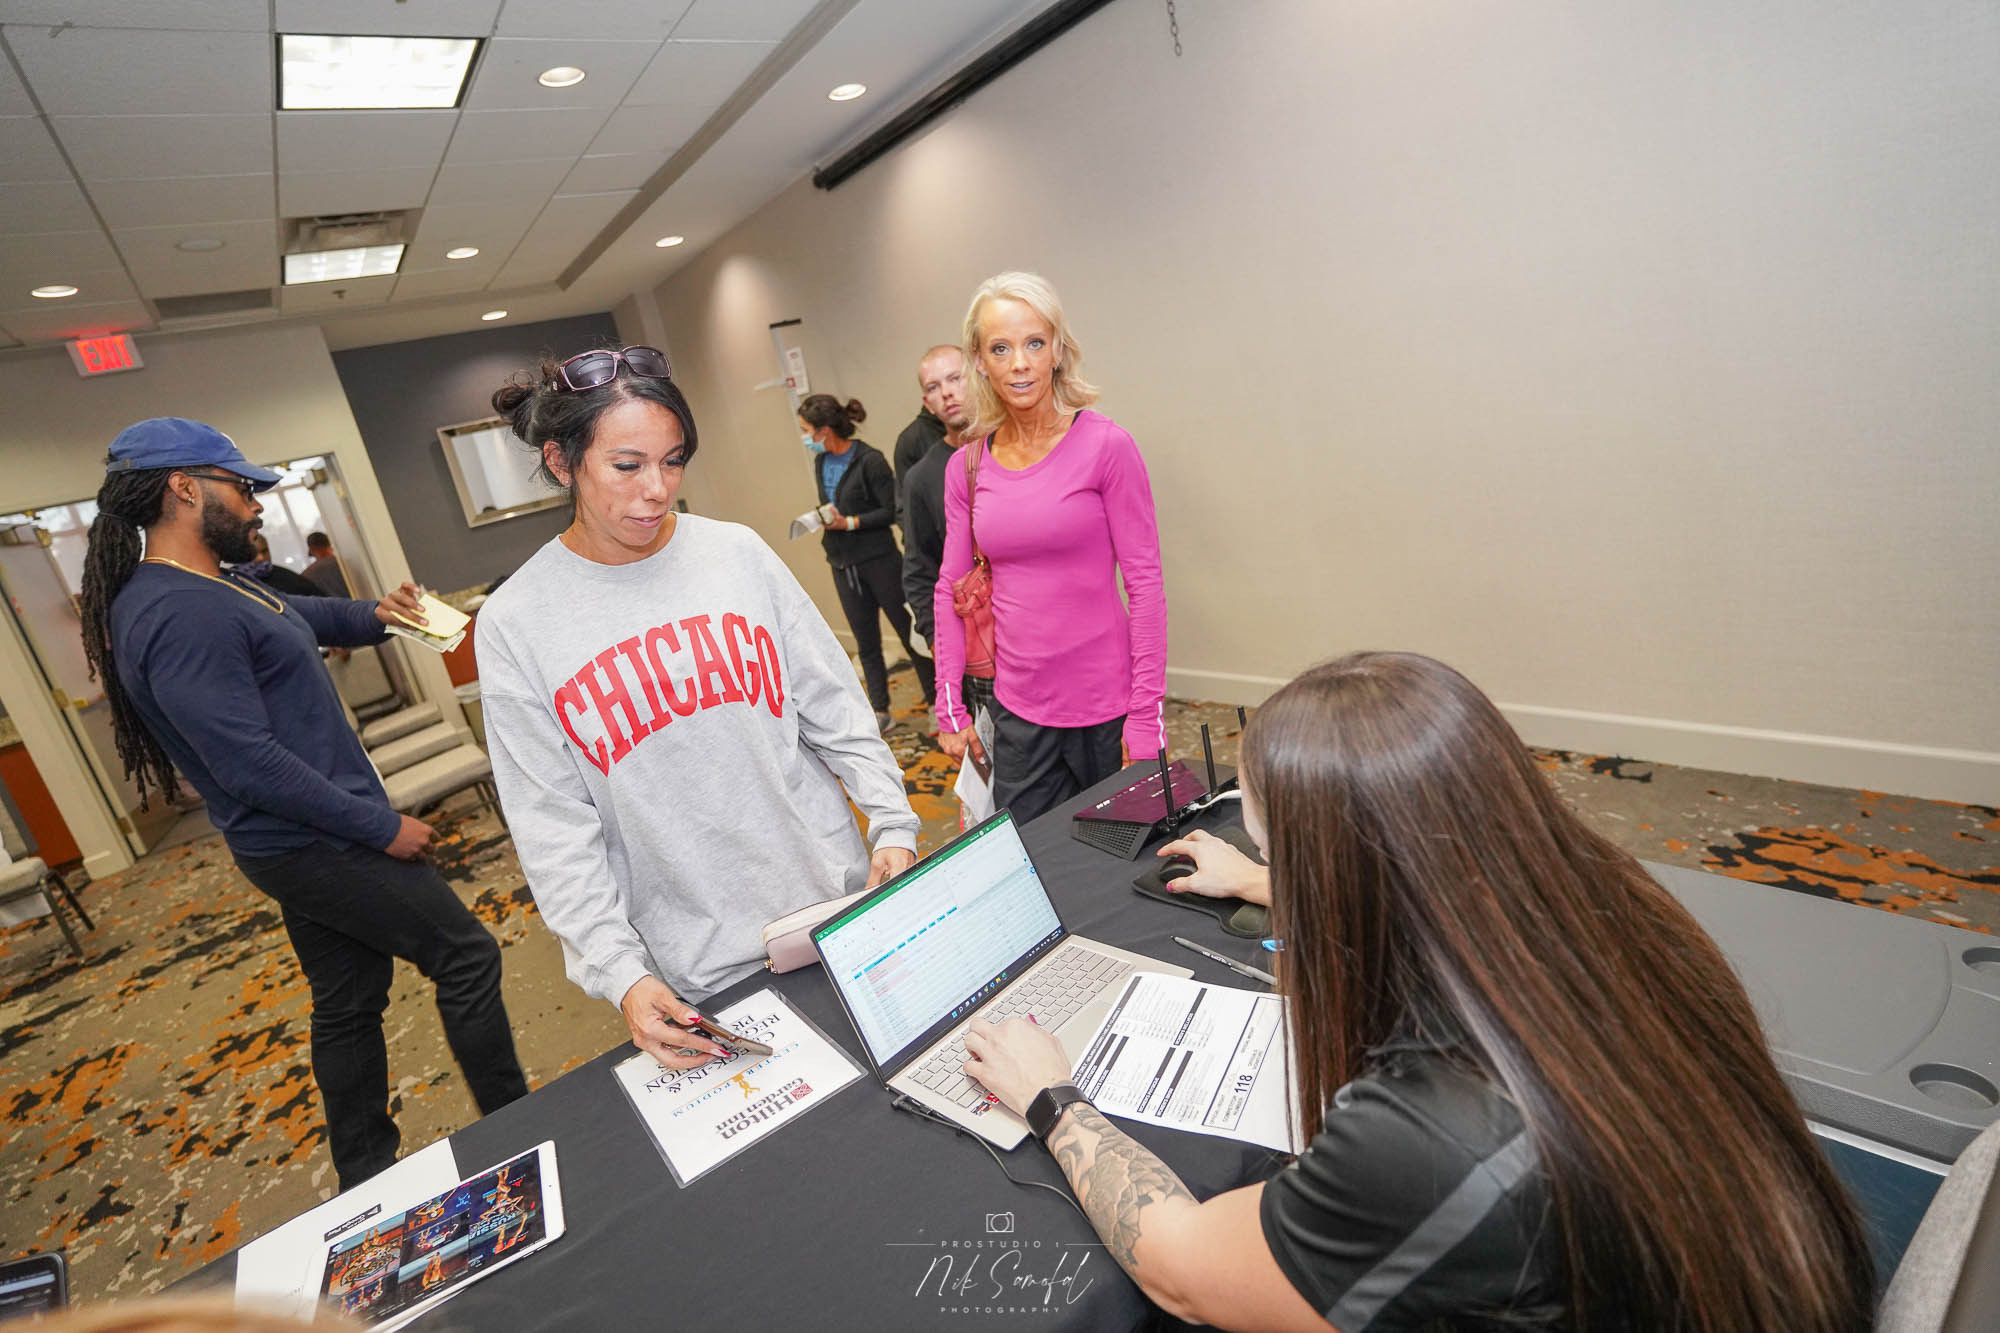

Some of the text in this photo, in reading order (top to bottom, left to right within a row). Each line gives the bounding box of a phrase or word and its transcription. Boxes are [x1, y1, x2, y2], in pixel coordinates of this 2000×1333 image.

[76, 336, 133, 373] EXIT
[554, 612, 784, 777] CHICAGO
[668, 1083, 681, 1094] &
[672, 1082, 731, 1118] PODIUM
[1234, 1074, 1253, 1093] 118
[716, 1077, 804, 1131] Garden Inn
[721, 1094, 795, 1139] Hilton
